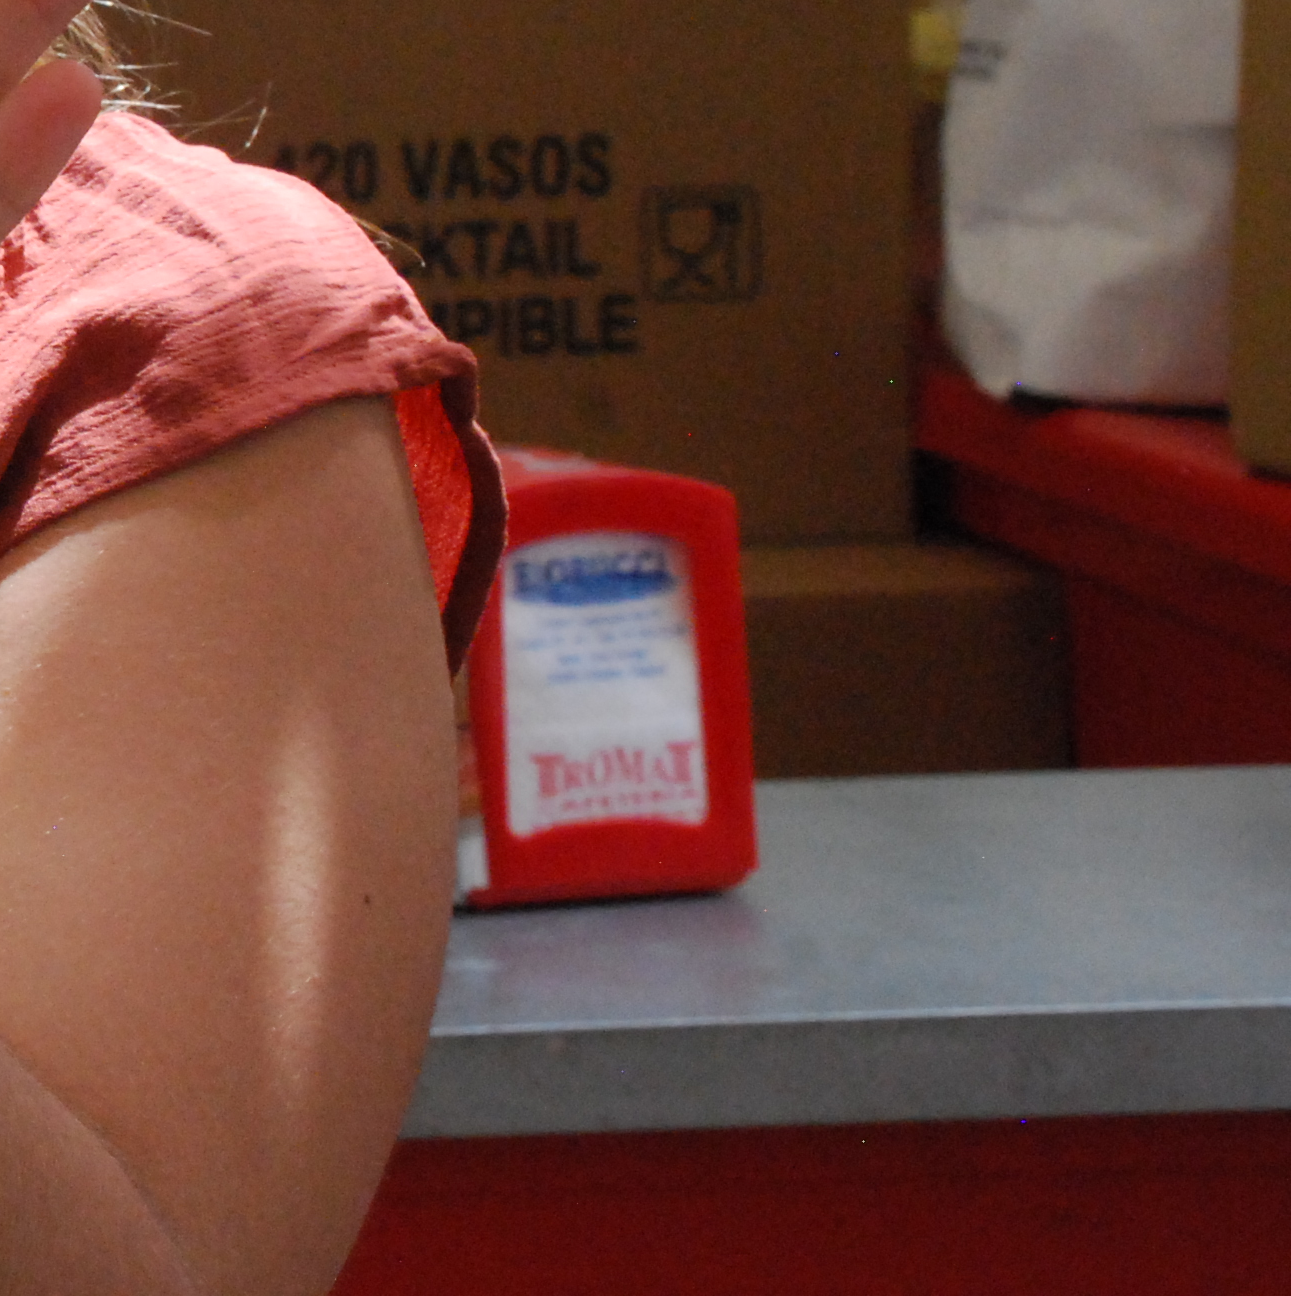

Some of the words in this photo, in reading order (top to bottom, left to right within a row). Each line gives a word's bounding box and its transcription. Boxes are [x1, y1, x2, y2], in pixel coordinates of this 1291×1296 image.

[401, 133, 612, 202] VASOS
[381, 218, 601, 280] CKTAIL
[431, 294, 641, 360] PIBLE
